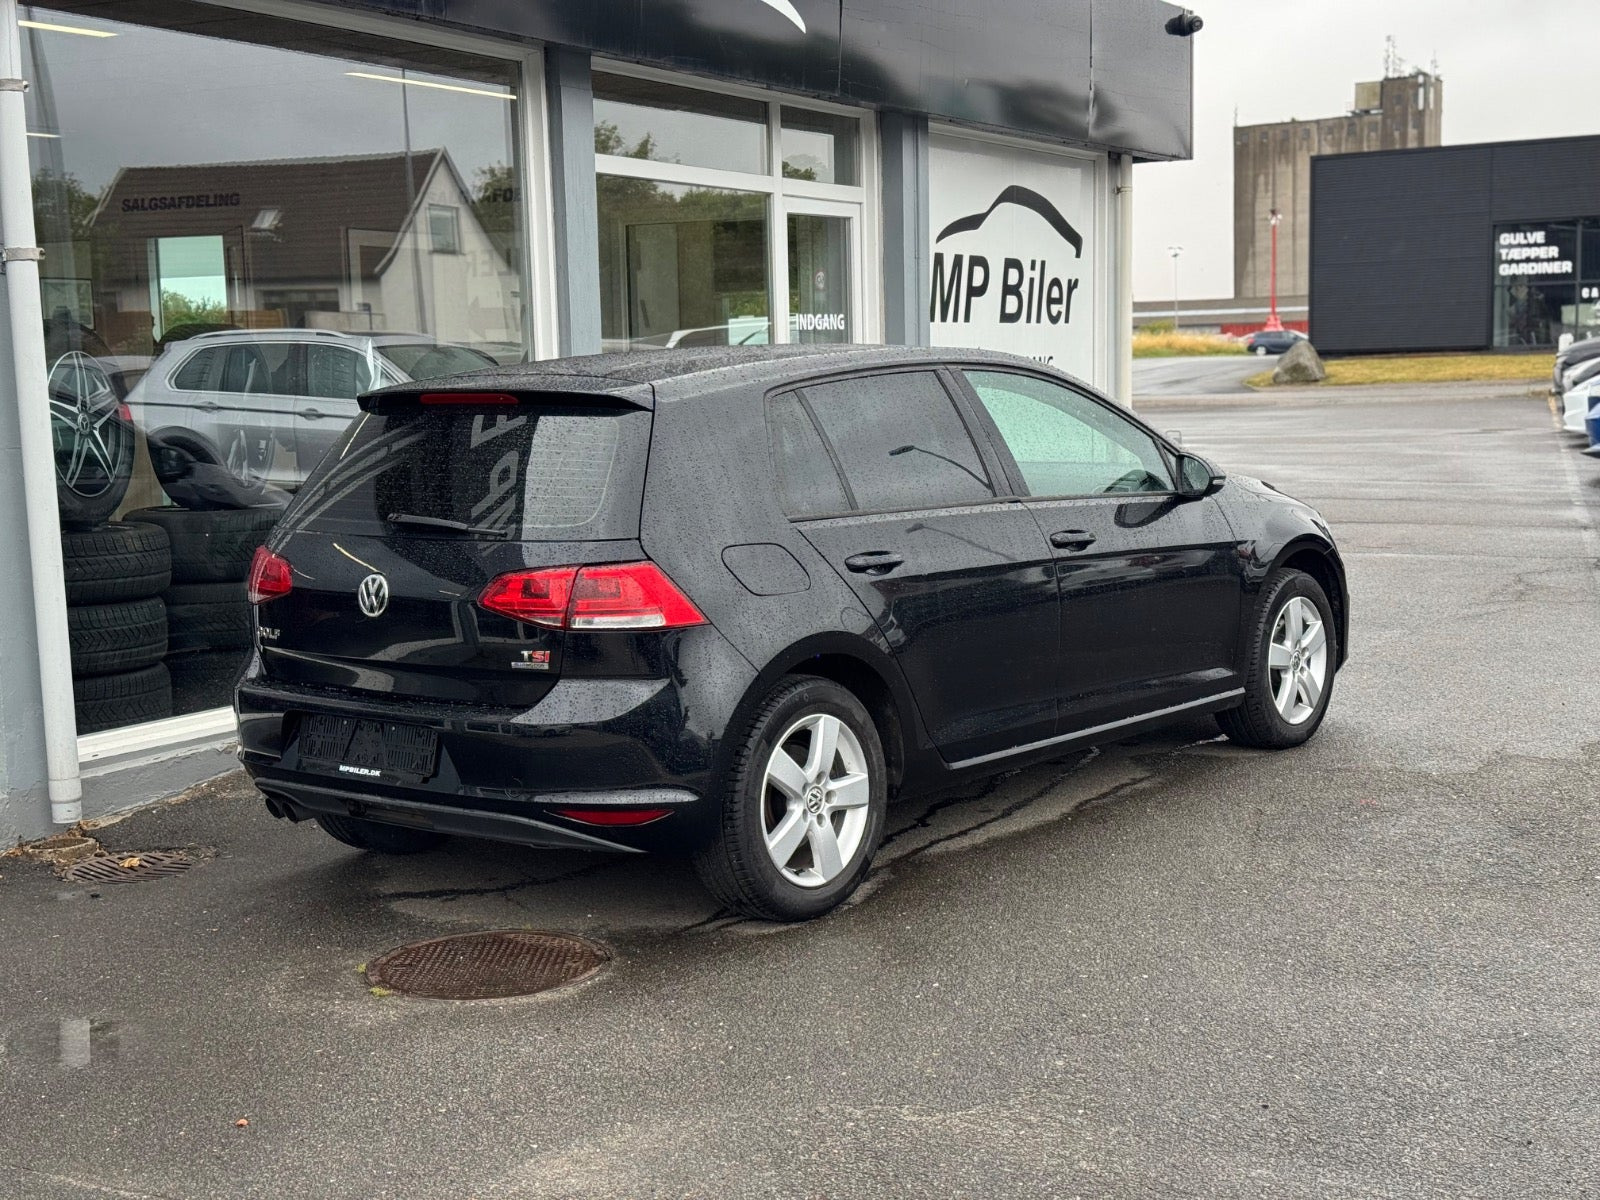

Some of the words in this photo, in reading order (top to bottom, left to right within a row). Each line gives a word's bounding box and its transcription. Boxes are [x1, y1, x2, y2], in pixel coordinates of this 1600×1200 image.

[121, 193, 240, 212] SALGSAFDELING
[1500, 231, 1545, 245] GULVE
[1500, 246, 1559, 260] TÆPPER
[1499, 261, 1573, 276] GARDINER
[930, 252, 990, 323] MP
[999, 257, 1079, 325] Biler
[796, 313, 845, 331] INDGANG
[520, 650, 551, 663] TSI
[338, 764, 382, 777] MPBILER.DK
